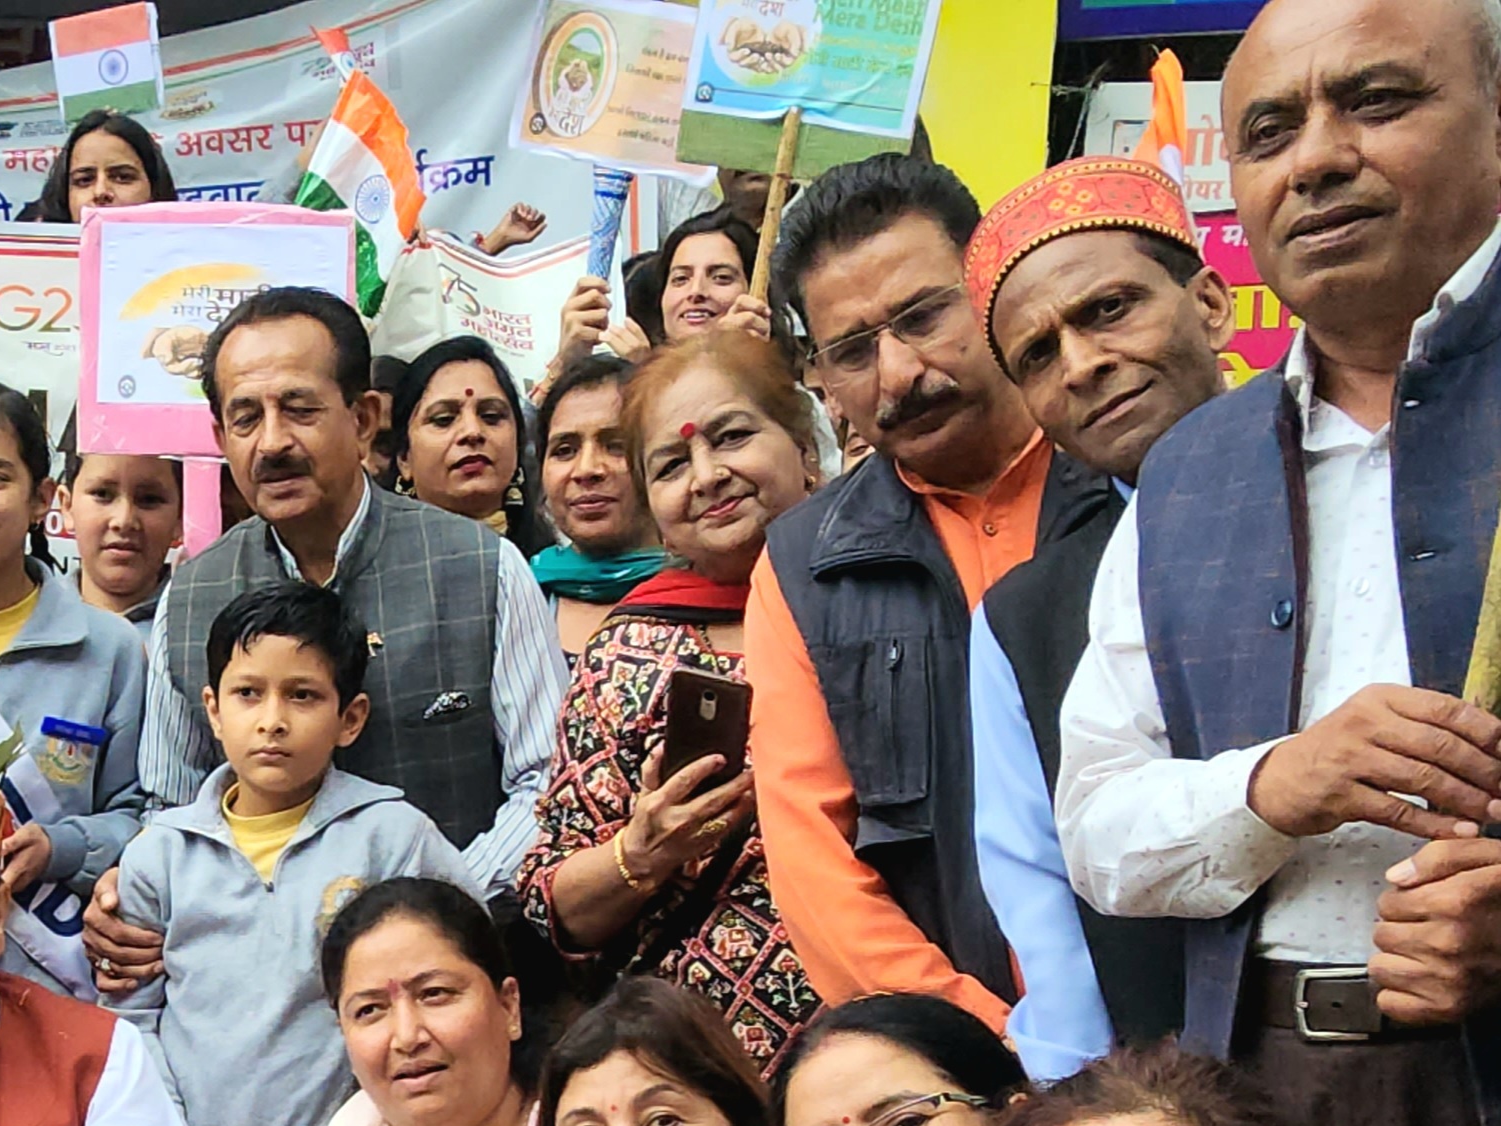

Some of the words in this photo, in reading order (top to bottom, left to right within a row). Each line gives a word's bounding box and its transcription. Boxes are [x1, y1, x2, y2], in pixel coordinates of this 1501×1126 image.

[176, 123, 273, 157] अवसर
[182, 284, 210, 299] मेरी
[172, 304, 201, 316] मेरा
[204, 301, 233, 322] दे
